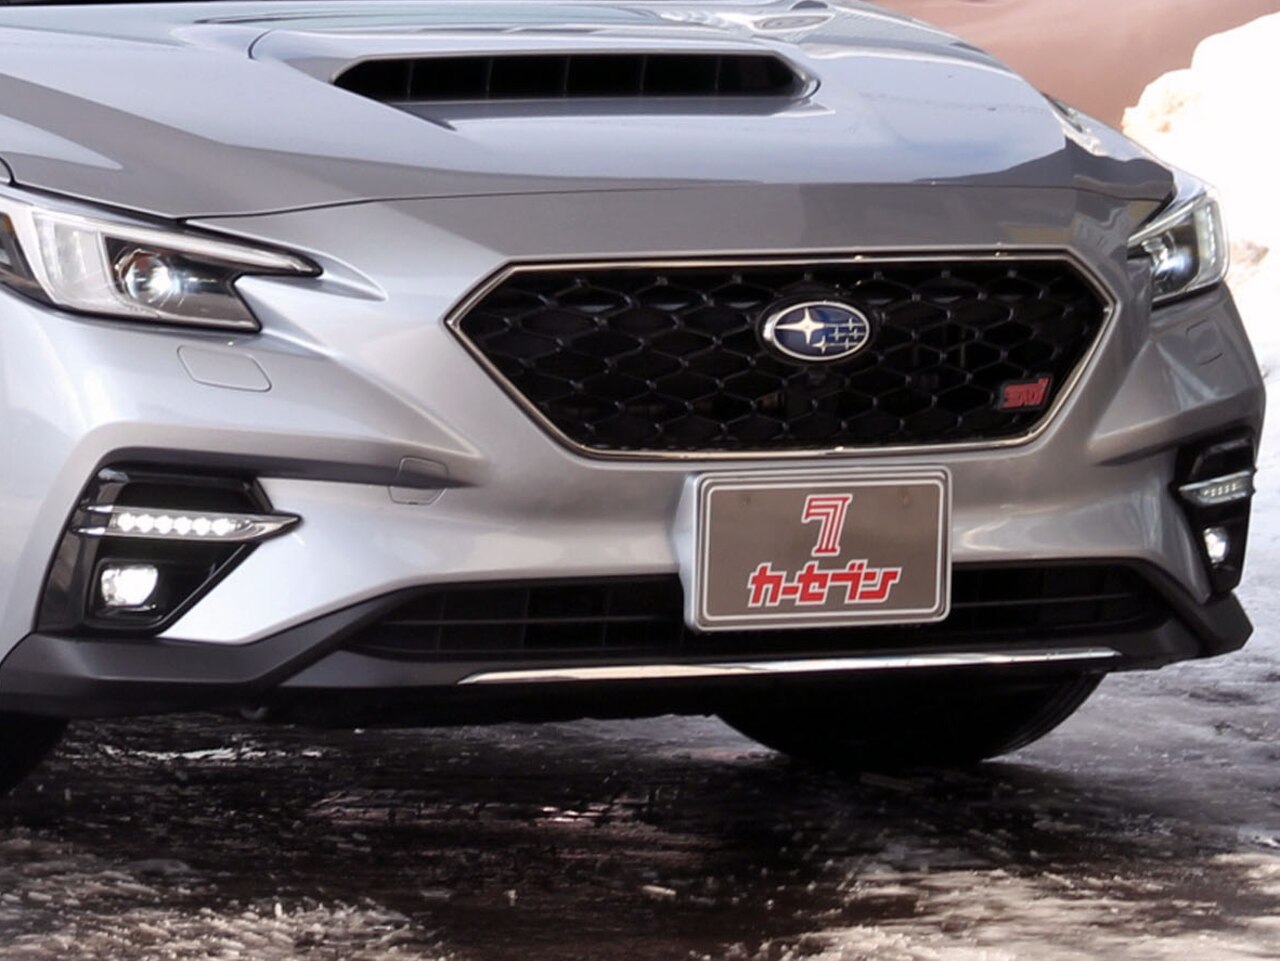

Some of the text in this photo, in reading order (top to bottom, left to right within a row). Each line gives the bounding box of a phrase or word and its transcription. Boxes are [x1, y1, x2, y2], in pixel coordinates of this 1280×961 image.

[748, 559, 902, 607] カーセブン
